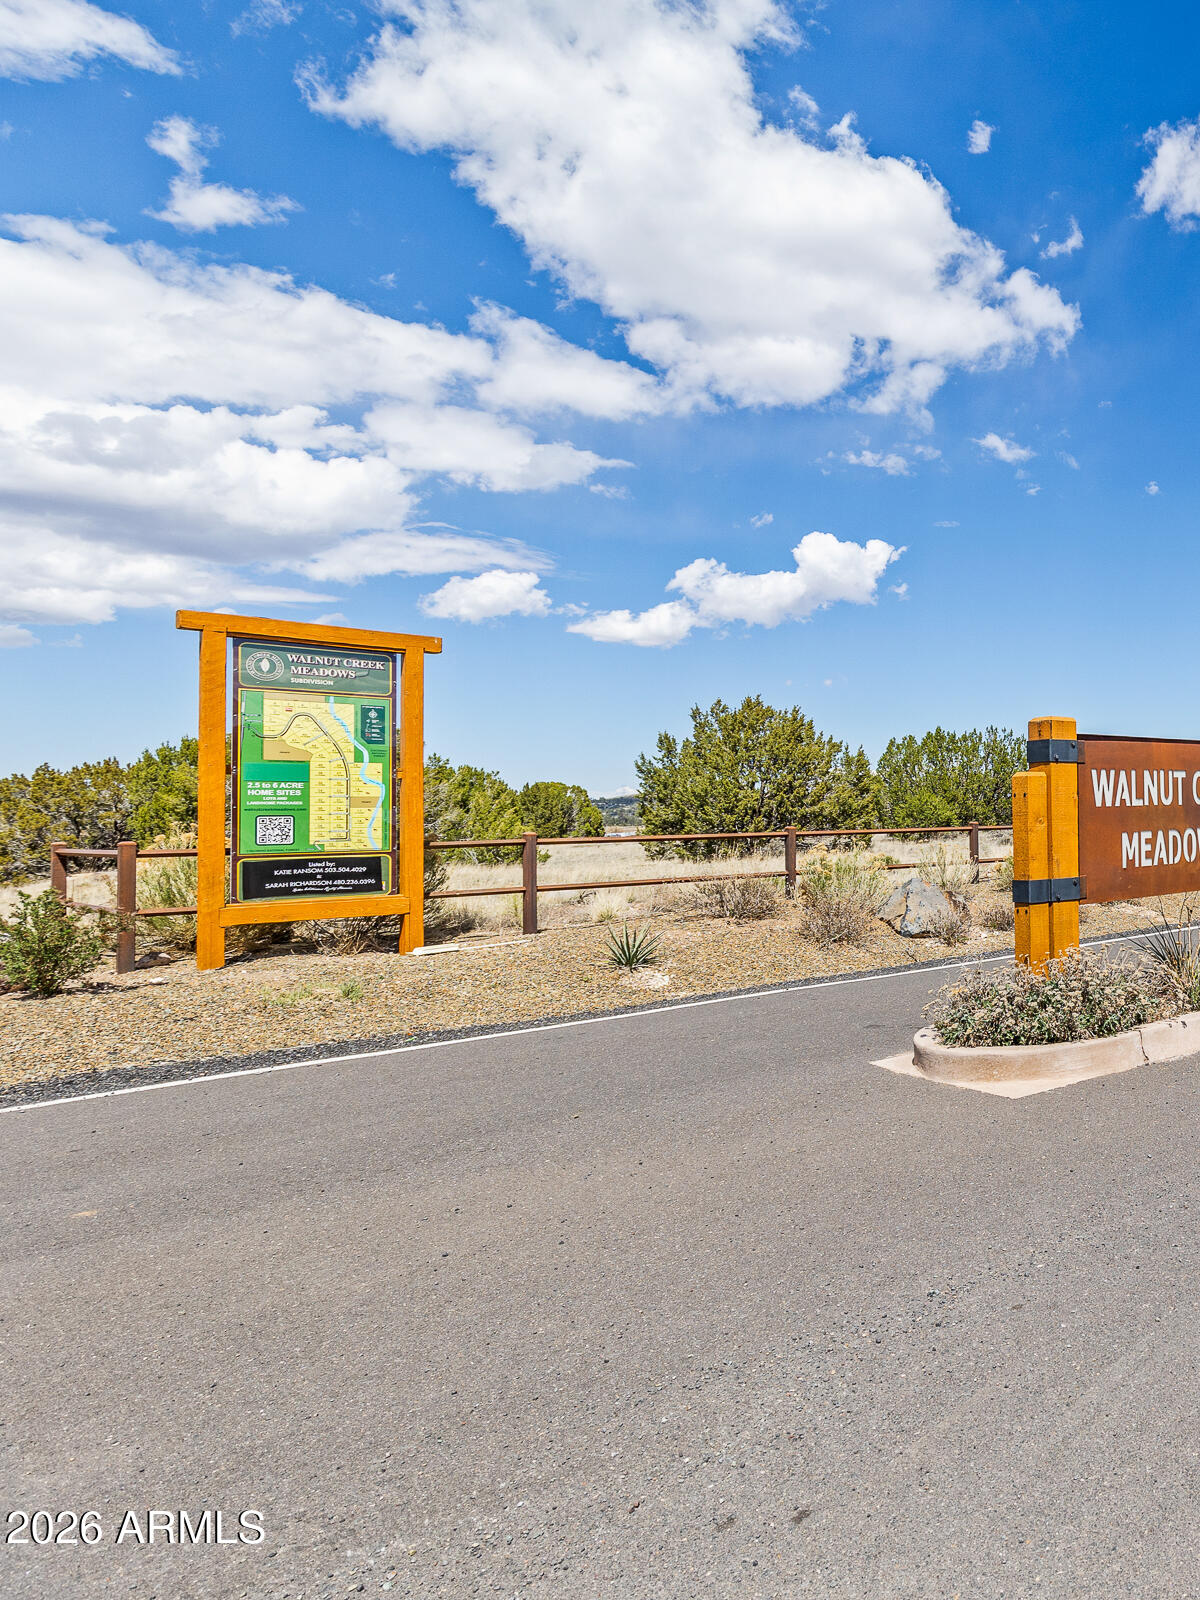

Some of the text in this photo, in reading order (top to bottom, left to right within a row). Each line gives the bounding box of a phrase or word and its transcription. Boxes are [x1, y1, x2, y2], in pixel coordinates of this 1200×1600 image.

[287, 654, 386, 670] WALNUT CREEK
[290, 666, 356, 678] MEADOWS
[1091, 769, 1186, 808] WALNUT
